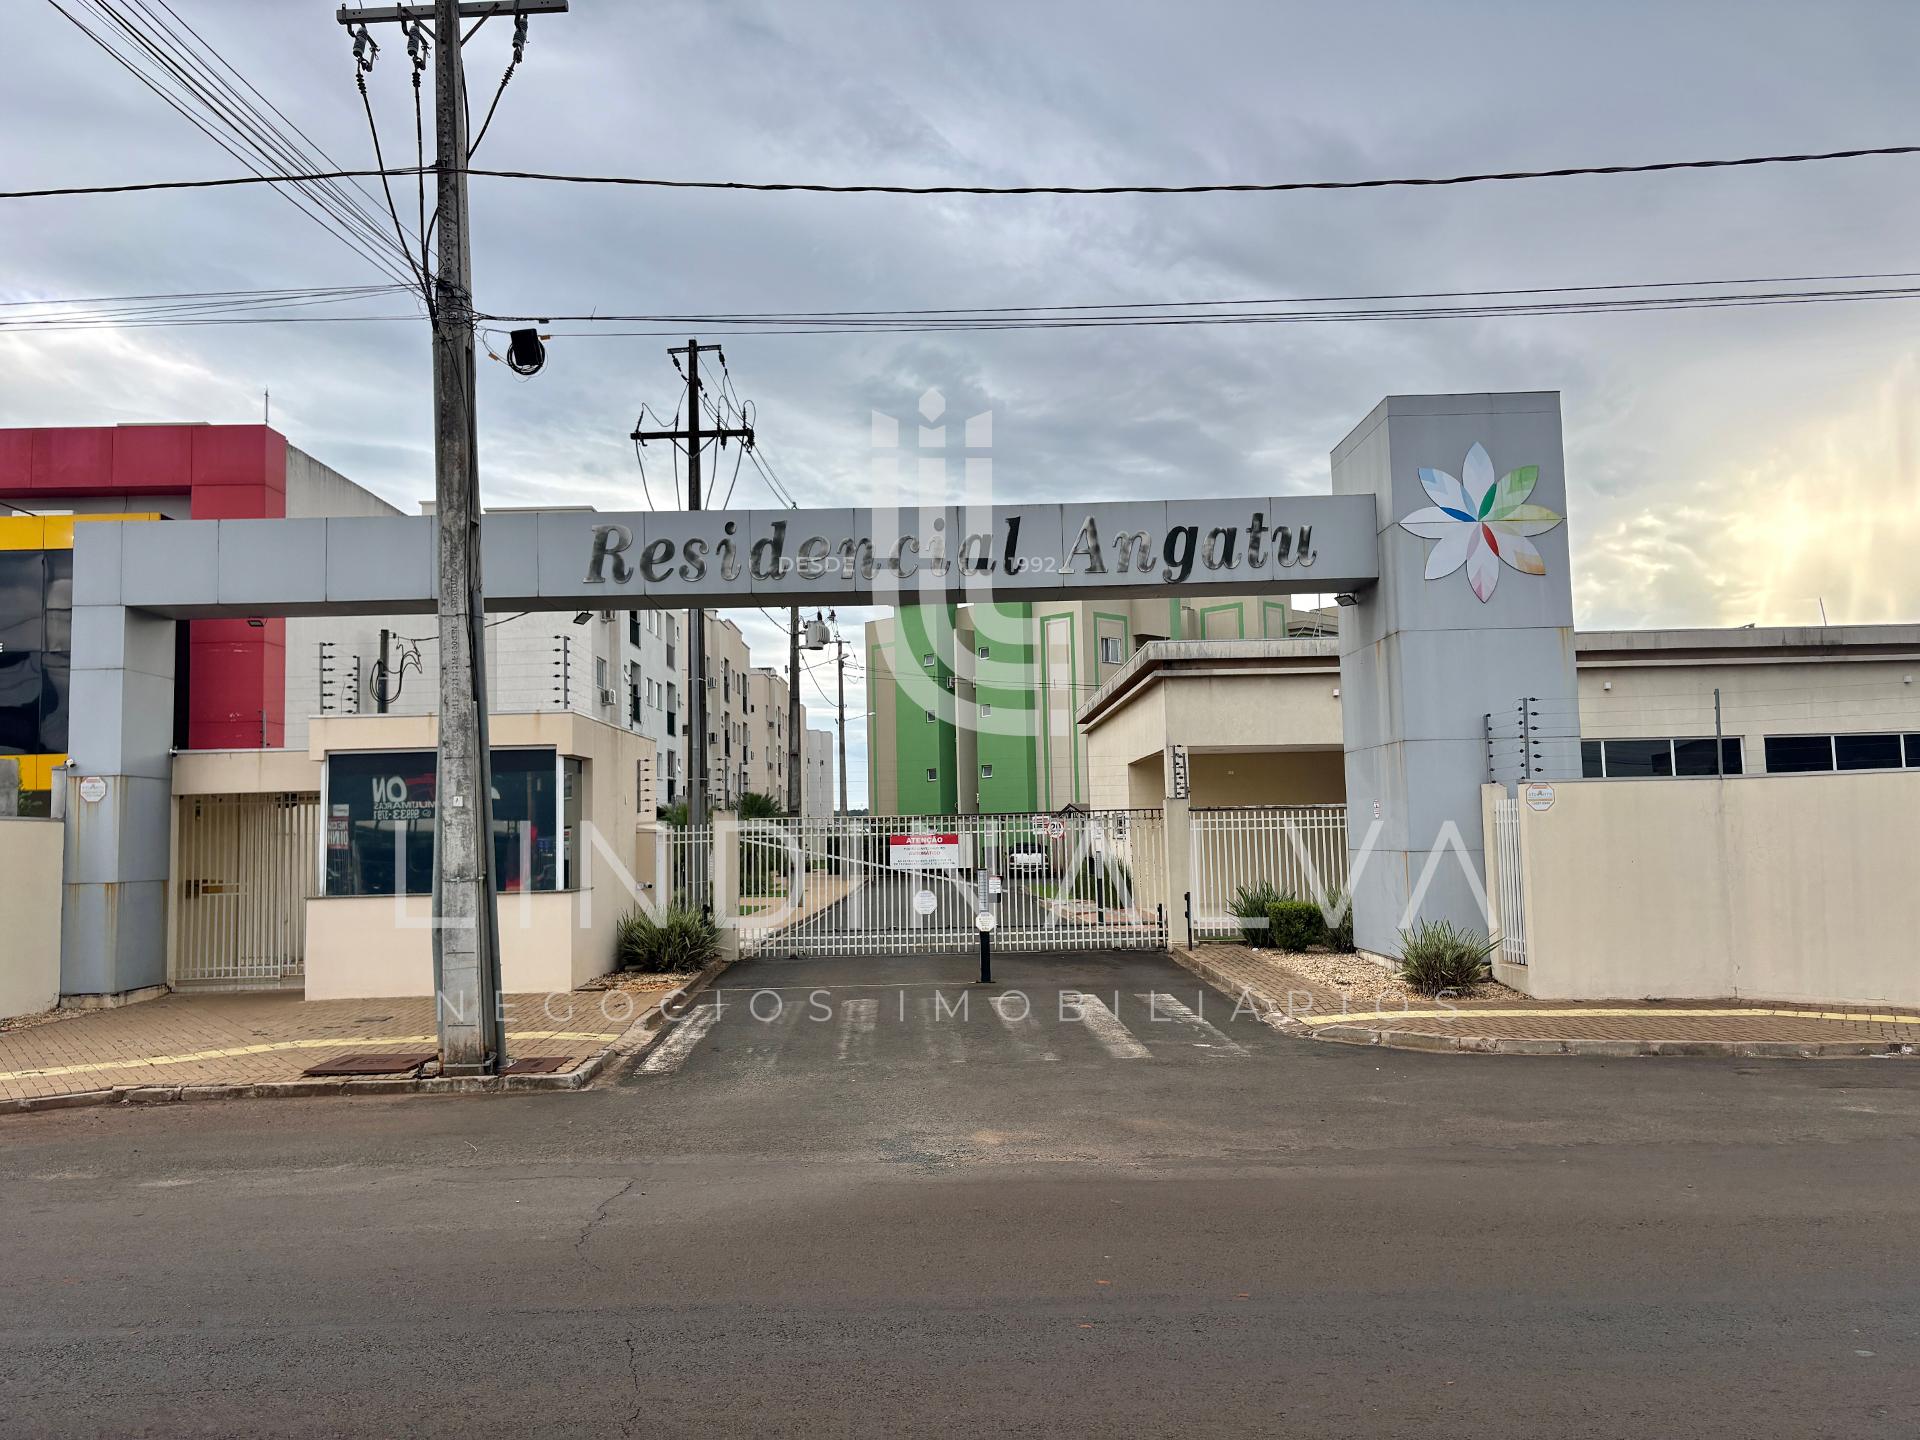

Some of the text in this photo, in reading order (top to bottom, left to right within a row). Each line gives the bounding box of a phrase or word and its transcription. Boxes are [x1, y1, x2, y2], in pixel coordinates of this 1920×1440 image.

[583, 512, 1317, 585] Residencial Angatu
[906, 836, 943, 844] ATENÇÃO
